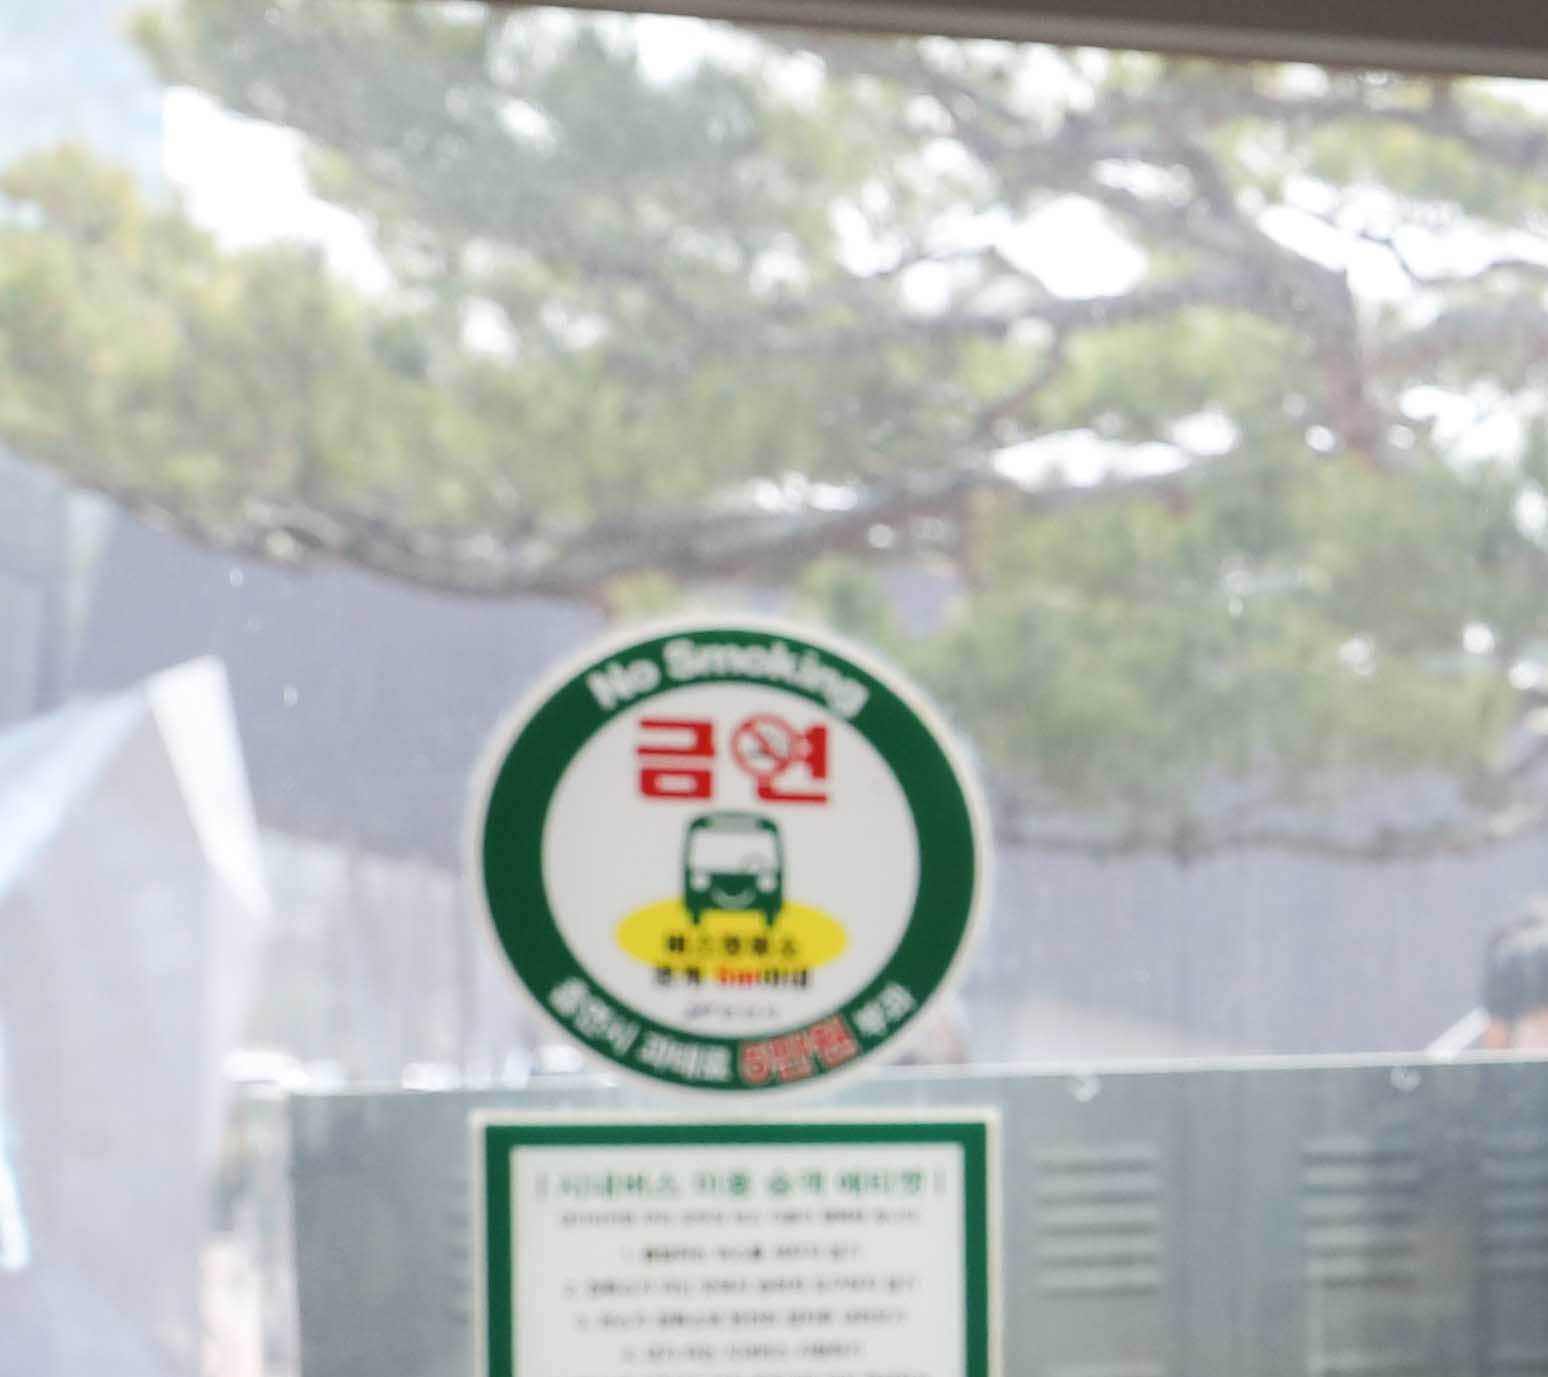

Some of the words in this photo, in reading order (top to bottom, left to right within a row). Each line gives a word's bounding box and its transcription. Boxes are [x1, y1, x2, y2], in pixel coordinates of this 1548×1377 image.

[587, 659, 661, 711] No
[663, 637, 870, 721] Smoking
[635, 714, 830, 804] 금연
